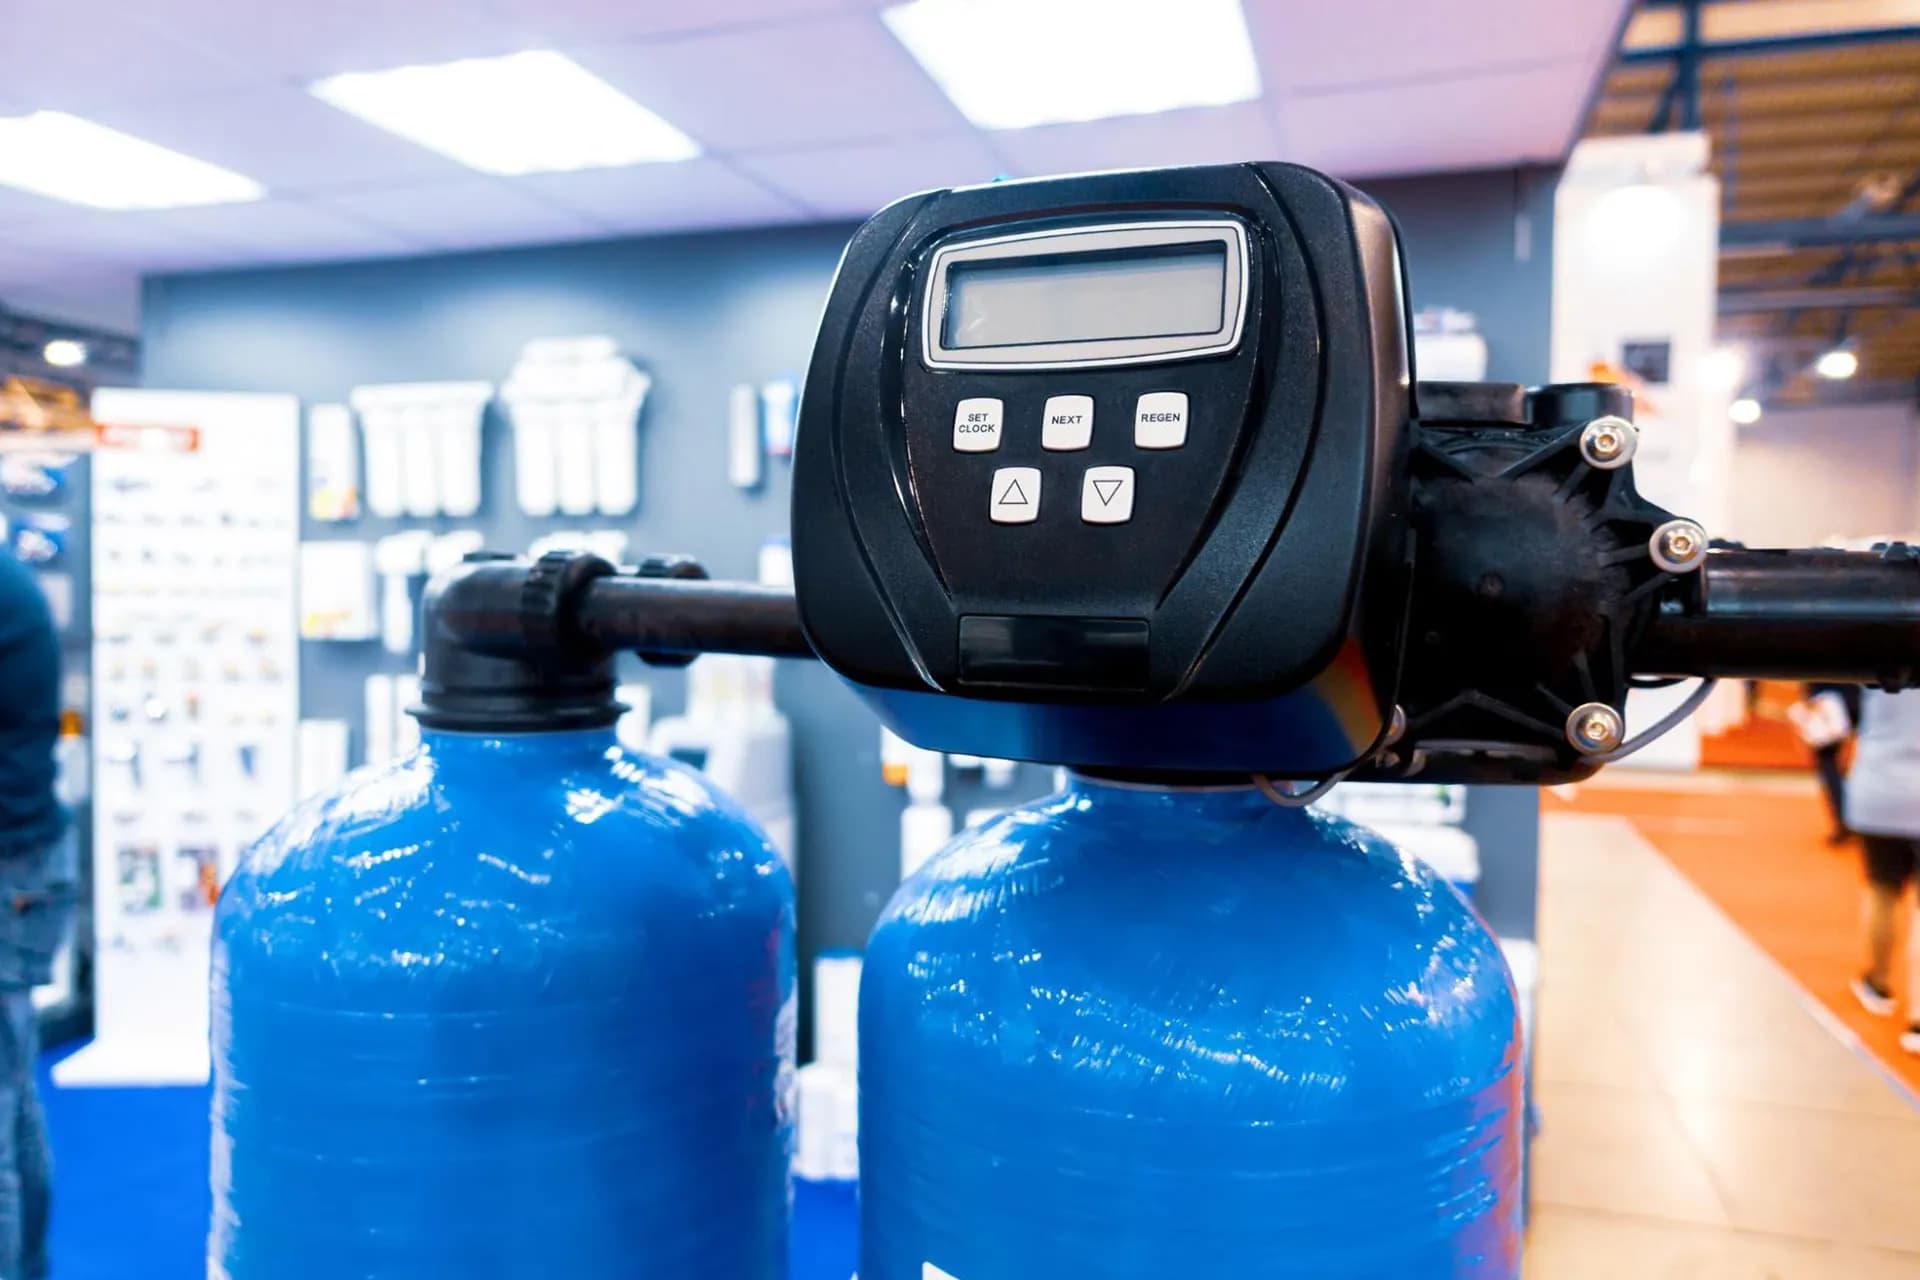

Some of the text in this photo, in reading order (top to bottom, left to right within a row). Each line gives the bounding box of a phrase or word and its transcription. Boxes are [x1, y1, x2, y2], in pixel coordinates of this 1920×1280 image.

[967, 412, 989, 423] SET
[1051, 415, 1083, 425] NEXT
[1140, 412, 1181, 423] REGEN
[958, 423, 996, 433] CLOCK
